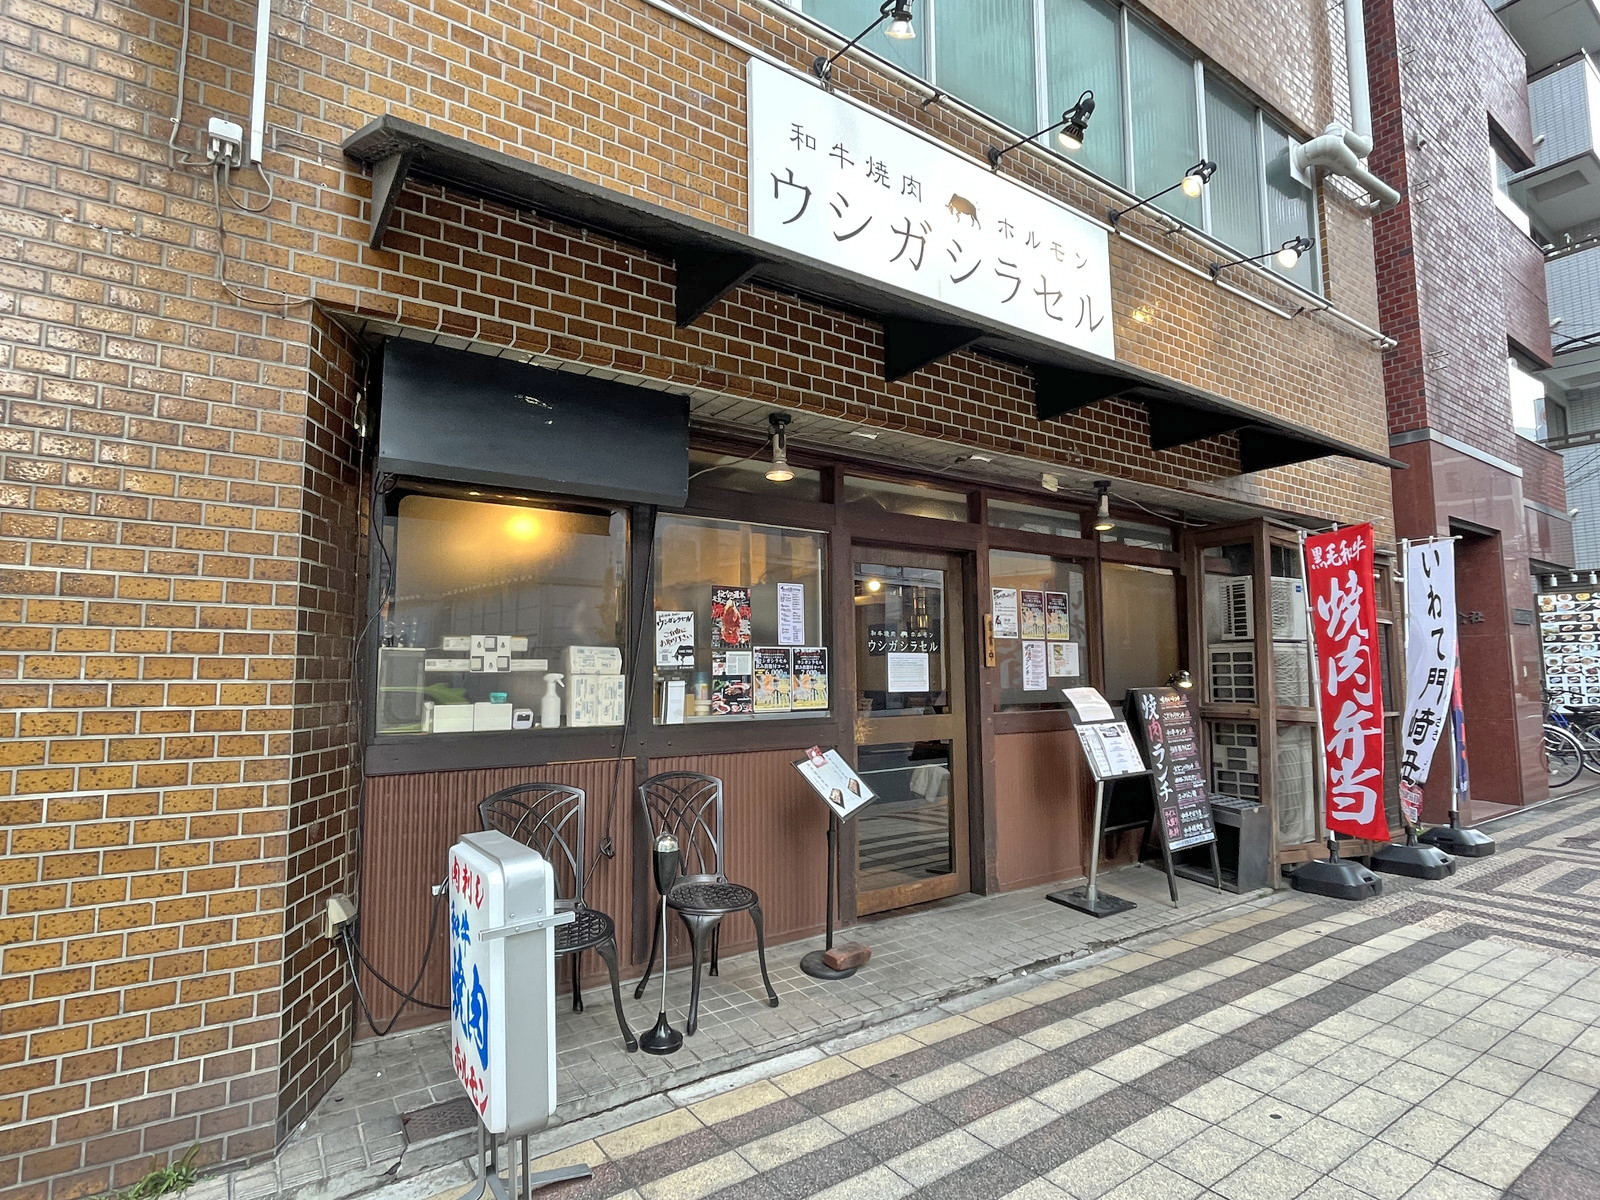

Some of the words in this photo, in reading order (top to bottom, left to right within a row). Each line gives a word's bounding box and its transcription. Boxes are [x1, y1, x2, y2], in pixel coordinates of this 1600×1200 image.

[790, 122, 922, 203] 和牛焼肉
[770, 167, 1105, 333] ウシガシラセル
[997, 217, 1088, 269] ホルモン
[1310, 534, 1367, 570] 黒毛和牛
[868, 639, 939, 652] ウシガシラセル
[1316, 569, 1382, 826] 焼肉弁当
[1141, 693, 1174, 803] 焼肉ランチ
[451, 943, 489, 1072] 焼肉
[453, 1037, 488, 1117] ホルモン
